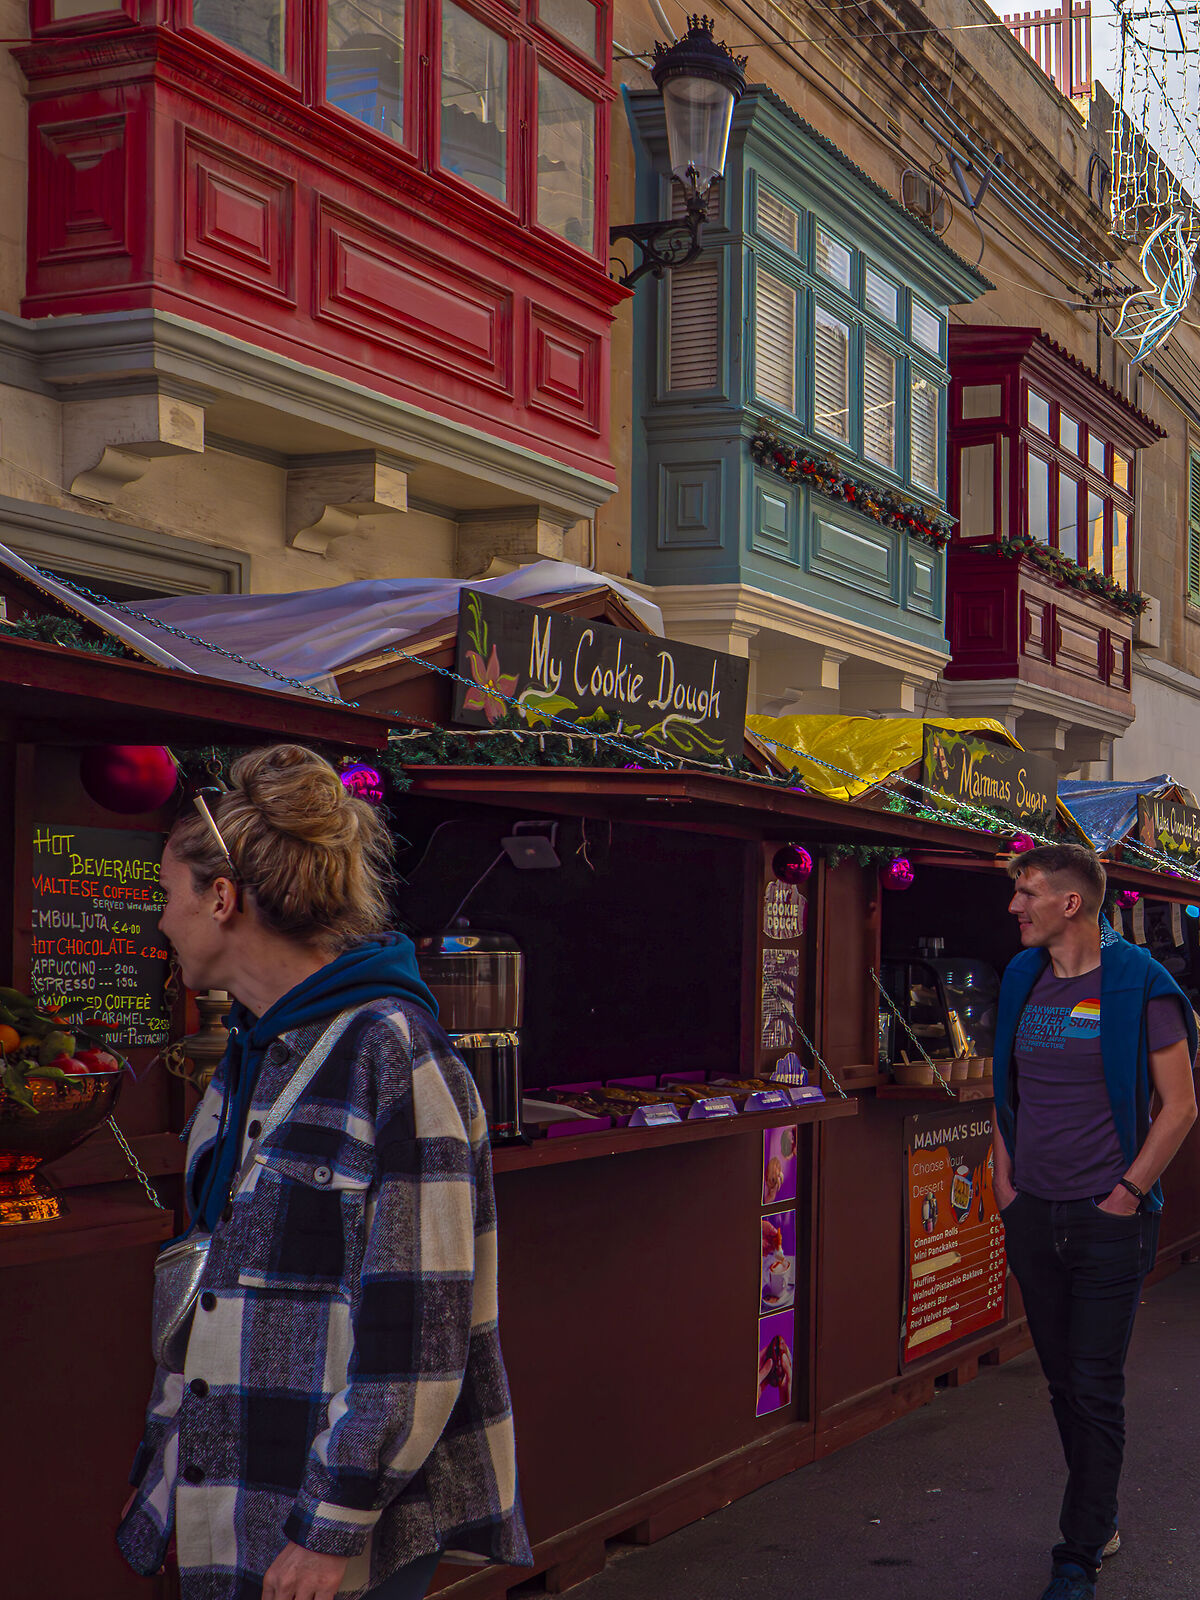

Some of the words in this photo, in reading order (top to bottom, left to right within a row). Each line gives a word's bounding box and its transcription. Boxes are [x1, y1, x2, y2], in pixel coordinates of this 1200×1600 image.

[518, 614, 562, 718] My
[574, 629, 644, 703] Cookie
[648, 651, 721, 740] Dough
[960, 753, 1011, 803] Mammas
[1016, 768, 1047, 818] Sugar
[33, 827, 76, 855] HOT
[69, 853, 161, 884] BEVERAGES
[32, 874, 100, 897] MALTESE
[103, 885, 150, 900] COFFEE
[92, 898, 125, 911] SERVED
[767, 903, 798, 916] COOKIE
[767, 917, 797, 930] DOUGH
[57, 937, 137, 956] CHOCOLATE
[32, 958, 96, 976] APPUCCINO
[36, 976, 96, 994] SPRESSO
[104, 993, 151, 1010] COFFEE
[1025, 1004, 1072, 1017] EAKWATER
[914, 1124, 968, 1149] MAMMA'S
[970, 1120, 993, 1137] SUG
[912, 1160, 944, 1176] Choose
[945, 1155, 964, 1169] Your
[912, 1180, 944, 1198] Dessert
[914, 1232, 944, 1249] Cinnamon
[944, 1226, 959, 1238] Rolls
[913, 1249, 928, 1261] Mini
[913, 1274, 936, 1289] Muffins
[911, 1297, 937, 1315] Snickers
[937, 1295, 948, 1305] Bar
[909, 1317, 923, 1329] Red
[923, 1310, 942, 1324] Velvet
[942, 1302, 960, 1315] Bomb
